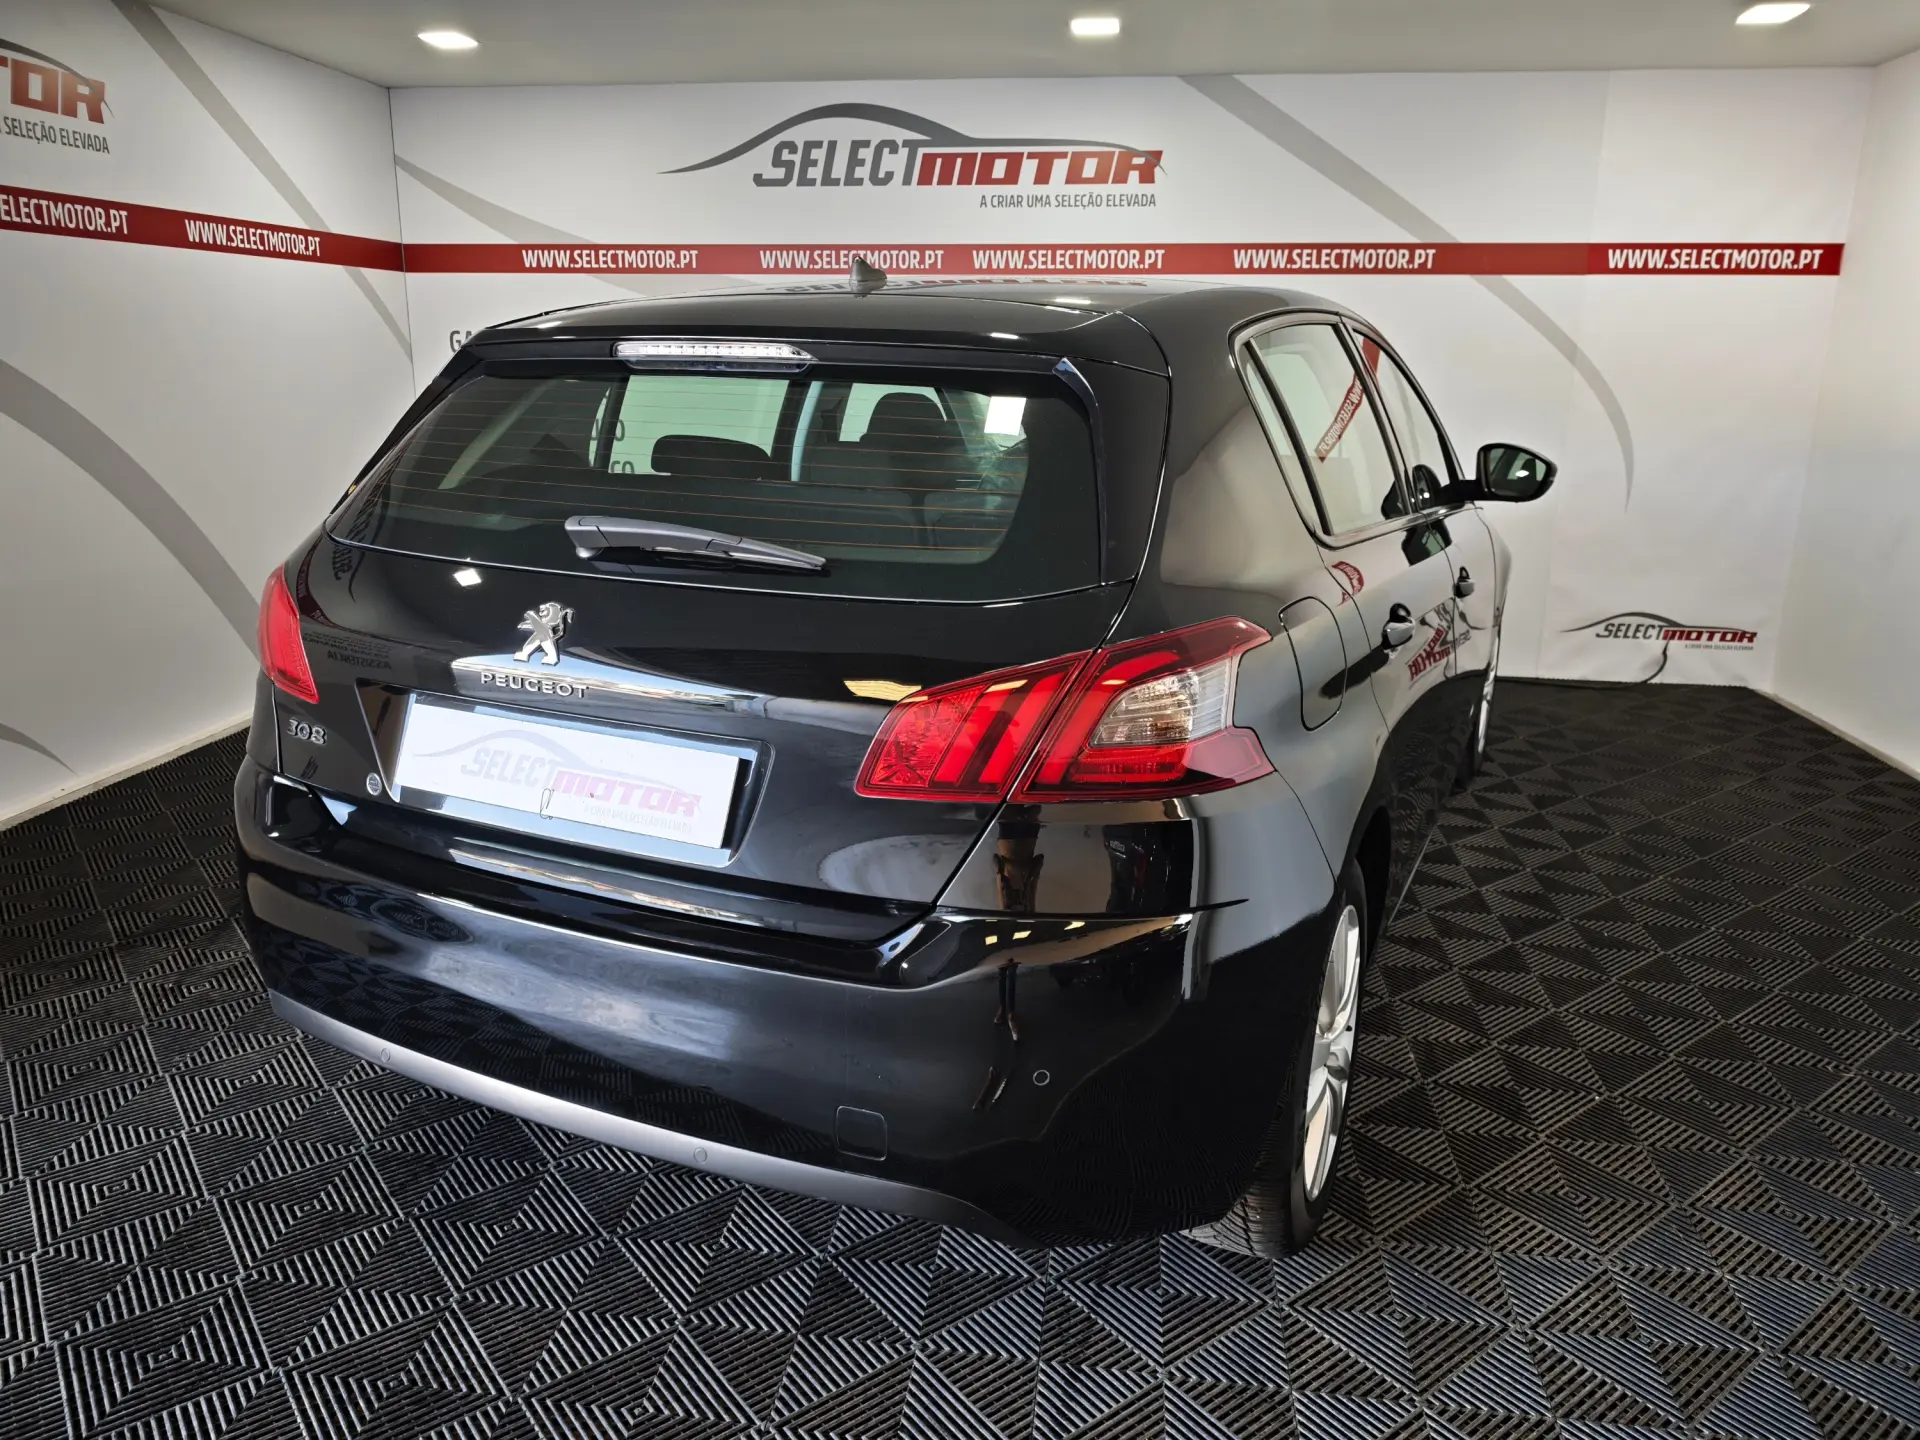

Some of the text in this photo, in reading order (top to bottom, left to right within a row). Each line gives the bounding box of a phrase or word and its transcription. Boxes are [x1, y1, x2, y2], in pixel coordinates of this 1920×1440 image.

[0, 54, 105, 124] OR
[4, 116, 110, 154] SELEÇÃO ELEVADA
[753, 139, 1163, 187] SELECTMOTOR
[0, 194, 128, 235] ELECTMOTOR.PT
[980, 192, 1156, 210] A CRIAR UMA SELEÇÃO ELEVADA
[184, 218, 320, 257] WWW.SELECTMOTOR.PT
[521, 249, 698, 269] WWW.SELECTMOTOR.PT
[972, 249, 1165, 269] WWW.SELECTMOTOR.PT
[1233, 248, 1436, 269] WWW.SELECTMOTOR.PT
[1607, 248, 1823, 269] WWW.SELECTMOTOR.PT
[1595, 623, 1758, 643] SELECTMOTOR
[480, 671, 590, 698] PEUGEOT
[286, 718, 326, 745] 308
[460, 748, 702, 818] SELECTMOTOR
